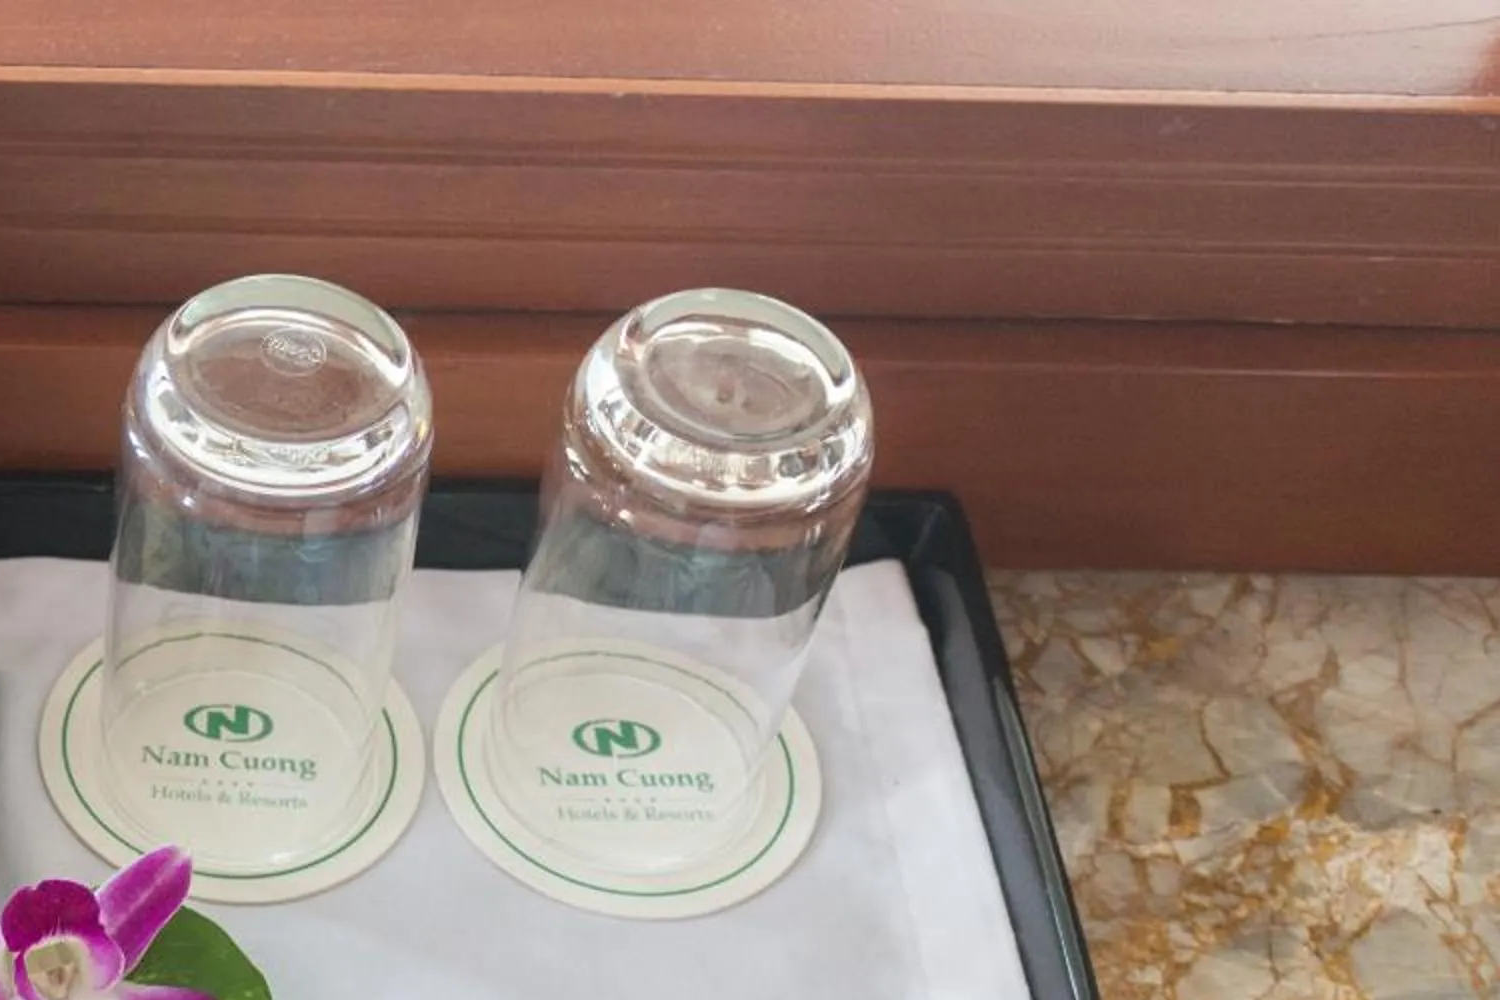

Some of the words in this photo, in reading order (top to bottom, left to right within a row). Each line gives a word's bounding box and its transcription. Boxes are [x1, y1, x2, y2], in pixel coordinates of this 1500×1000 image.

[142, 745, 209, 767] Nam
[219, 750, 317, 781] Cuong
[538, 766, 608, 786] Nam
[617, 768, 715, 793] Cuong
[152, 784, 211, 802] Hotels
[218, 790, 231, 804] &
[239, 790, 308, 809] Resorts
[557, 805, 617, 822] Hotels
[623, 808, 638, 821] &
[644, 805, 715, 823] Resorts
